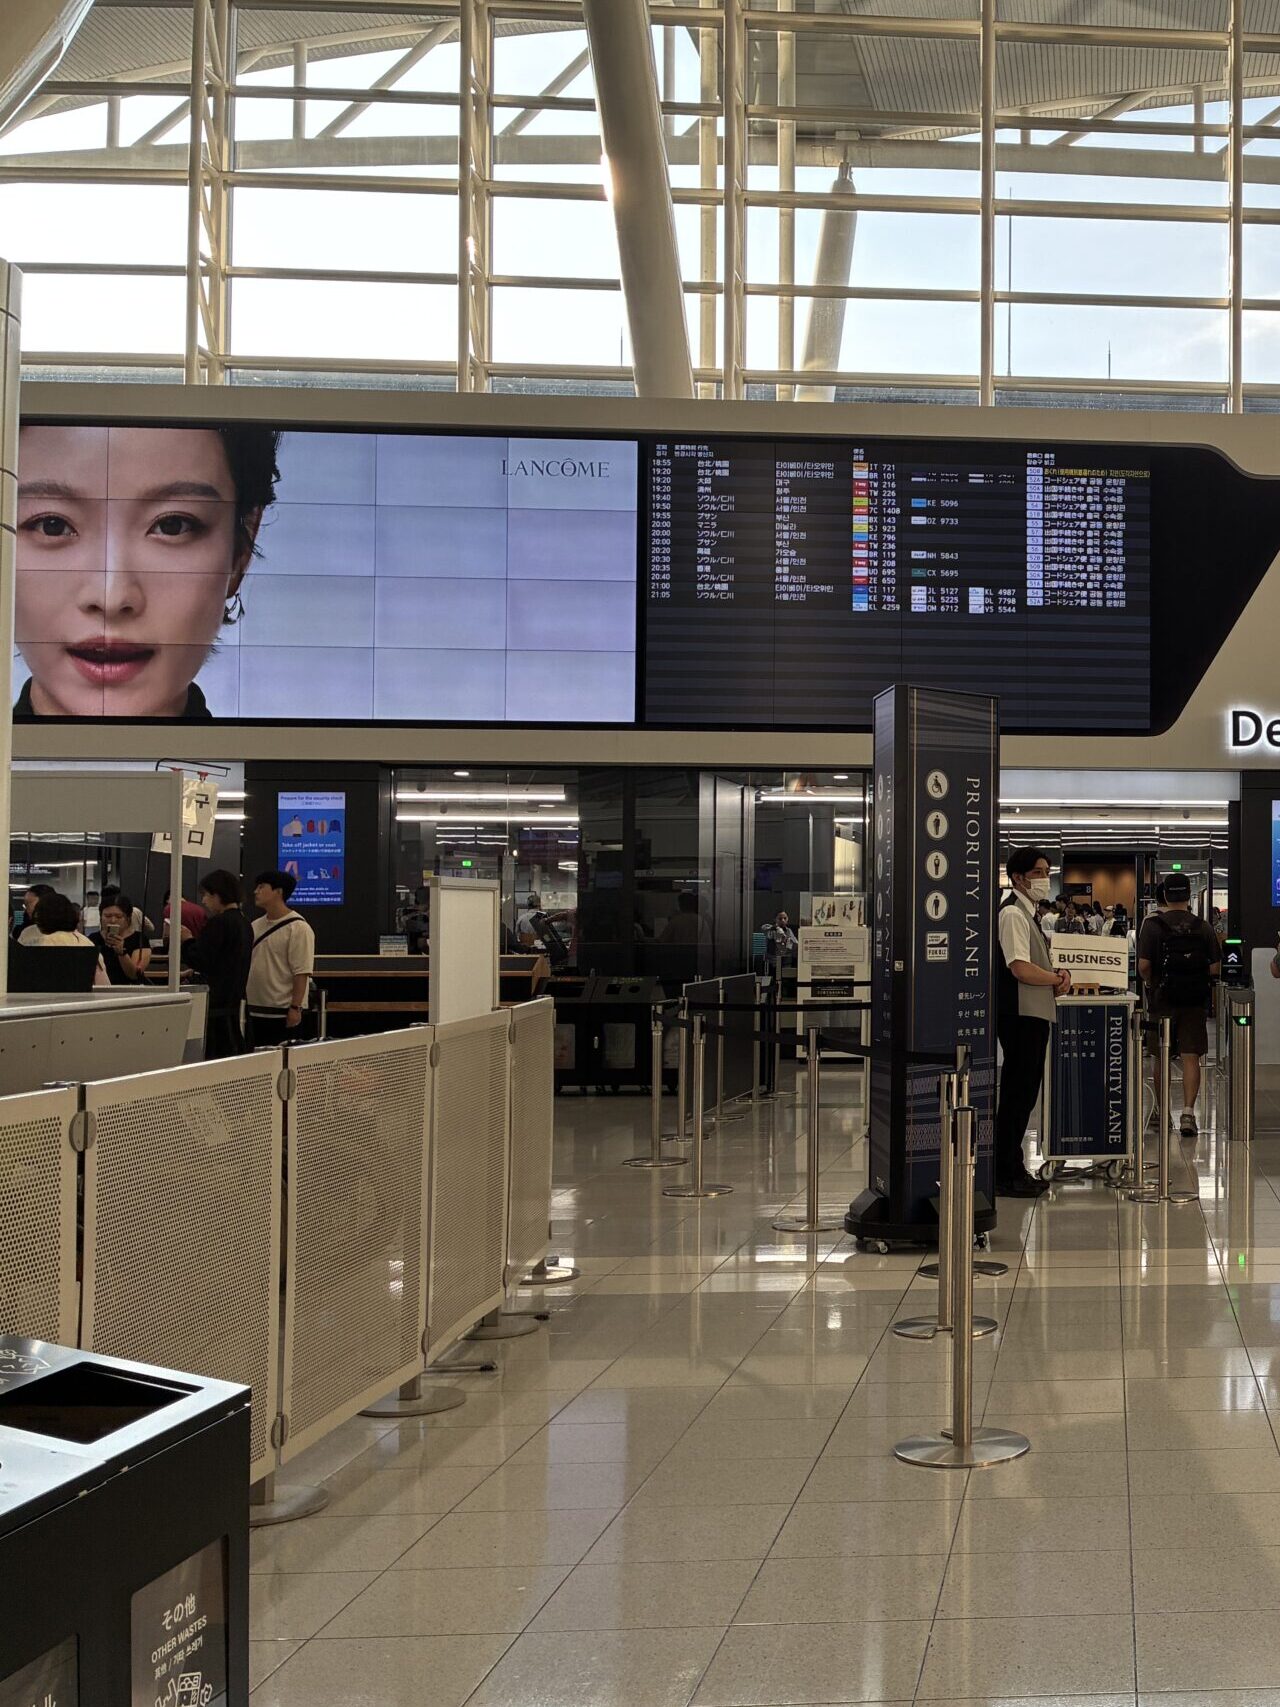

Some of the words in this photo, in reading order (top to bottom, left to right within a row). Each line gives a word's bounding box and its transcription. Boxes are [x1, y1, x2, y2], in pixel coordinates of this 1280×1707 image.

[501, 458, 609, 477] LANCÔME
[966, 777, 980, 900] PRIORITY
[1086, 885, 1091, 893] 8
[965, 913, 979, 977] LANE
[1058, 953, 1121, 966] BUSINESS
[1109, 1016, 1123, 1095] PRIORITY
[1108, 1100, 1122, 1144] LANE
[162, 1593, 196, 1630] その他
[151, 1637, 177, 1664] OTHER
[177, 1615, 208, 1645] WASTES
